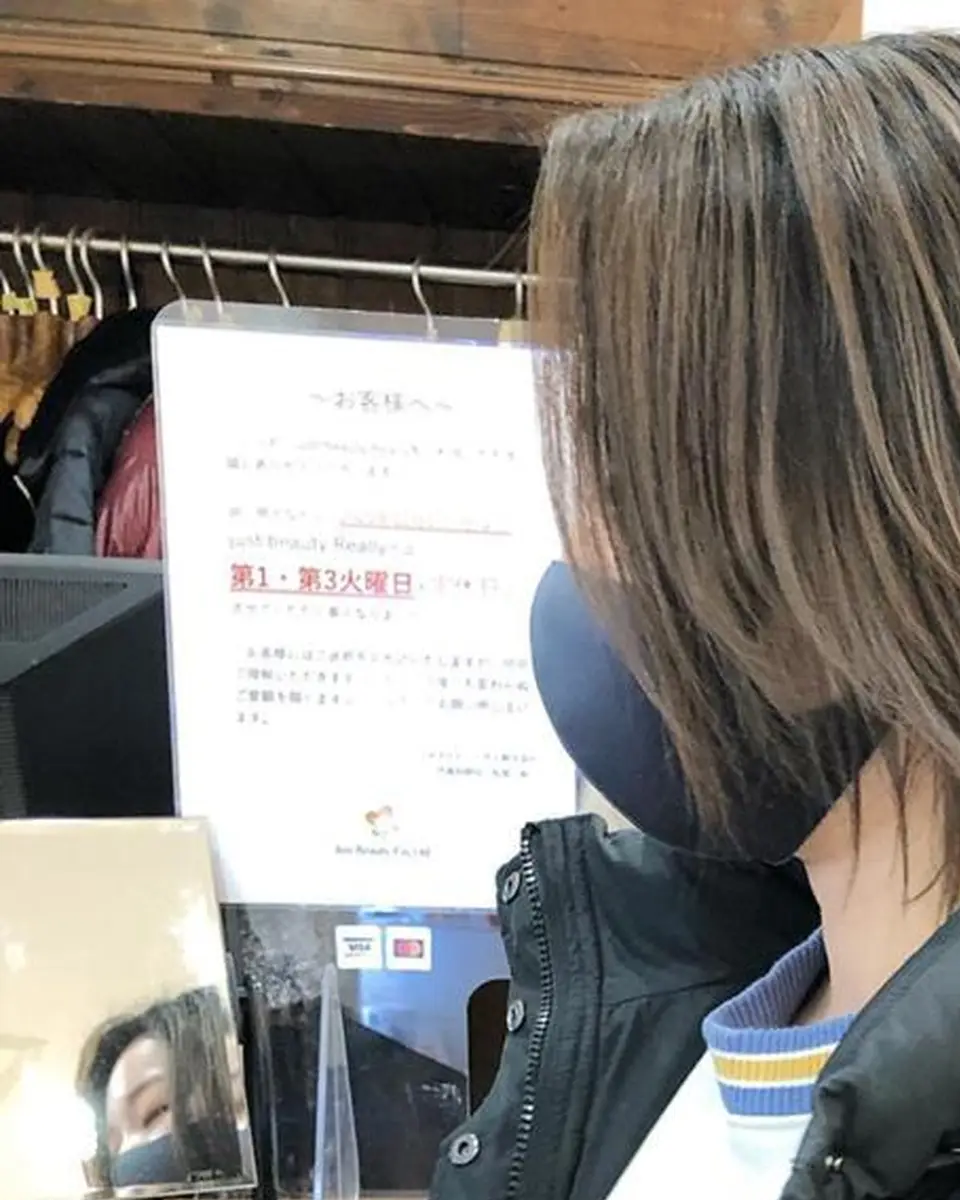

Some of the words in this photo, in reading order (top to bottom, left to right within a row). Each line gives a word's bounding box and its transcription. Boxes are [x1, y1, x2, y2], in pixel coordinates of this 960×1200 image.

[230, 563, 412, 596] 第1・第3火曜日
